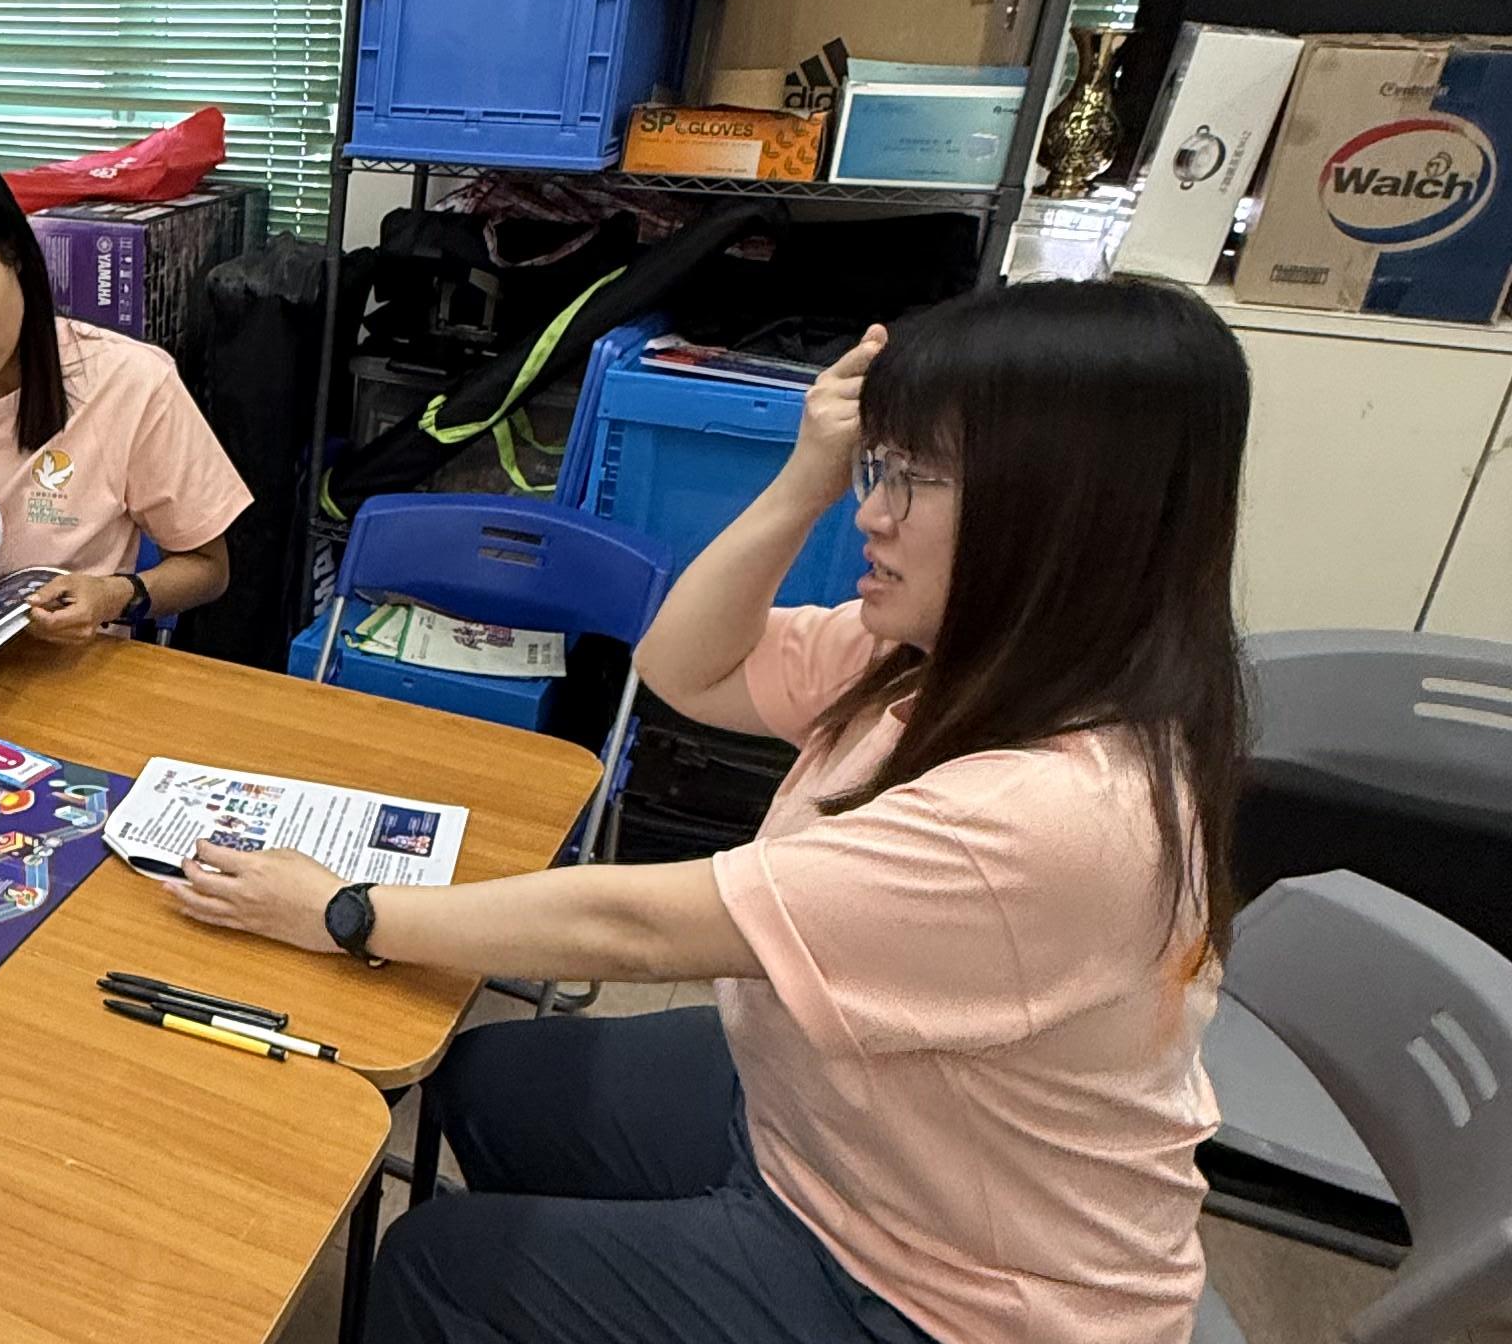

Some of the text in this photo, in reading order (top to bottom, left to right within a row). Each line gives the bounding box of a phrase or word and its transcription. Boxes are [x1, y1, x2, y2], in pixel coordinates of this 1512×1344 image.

[640, 108, 754, 138] SP GLOVES
[1333, 166, 1476, 201] Walch
[98, 254, 112, 306] YAMAHA
